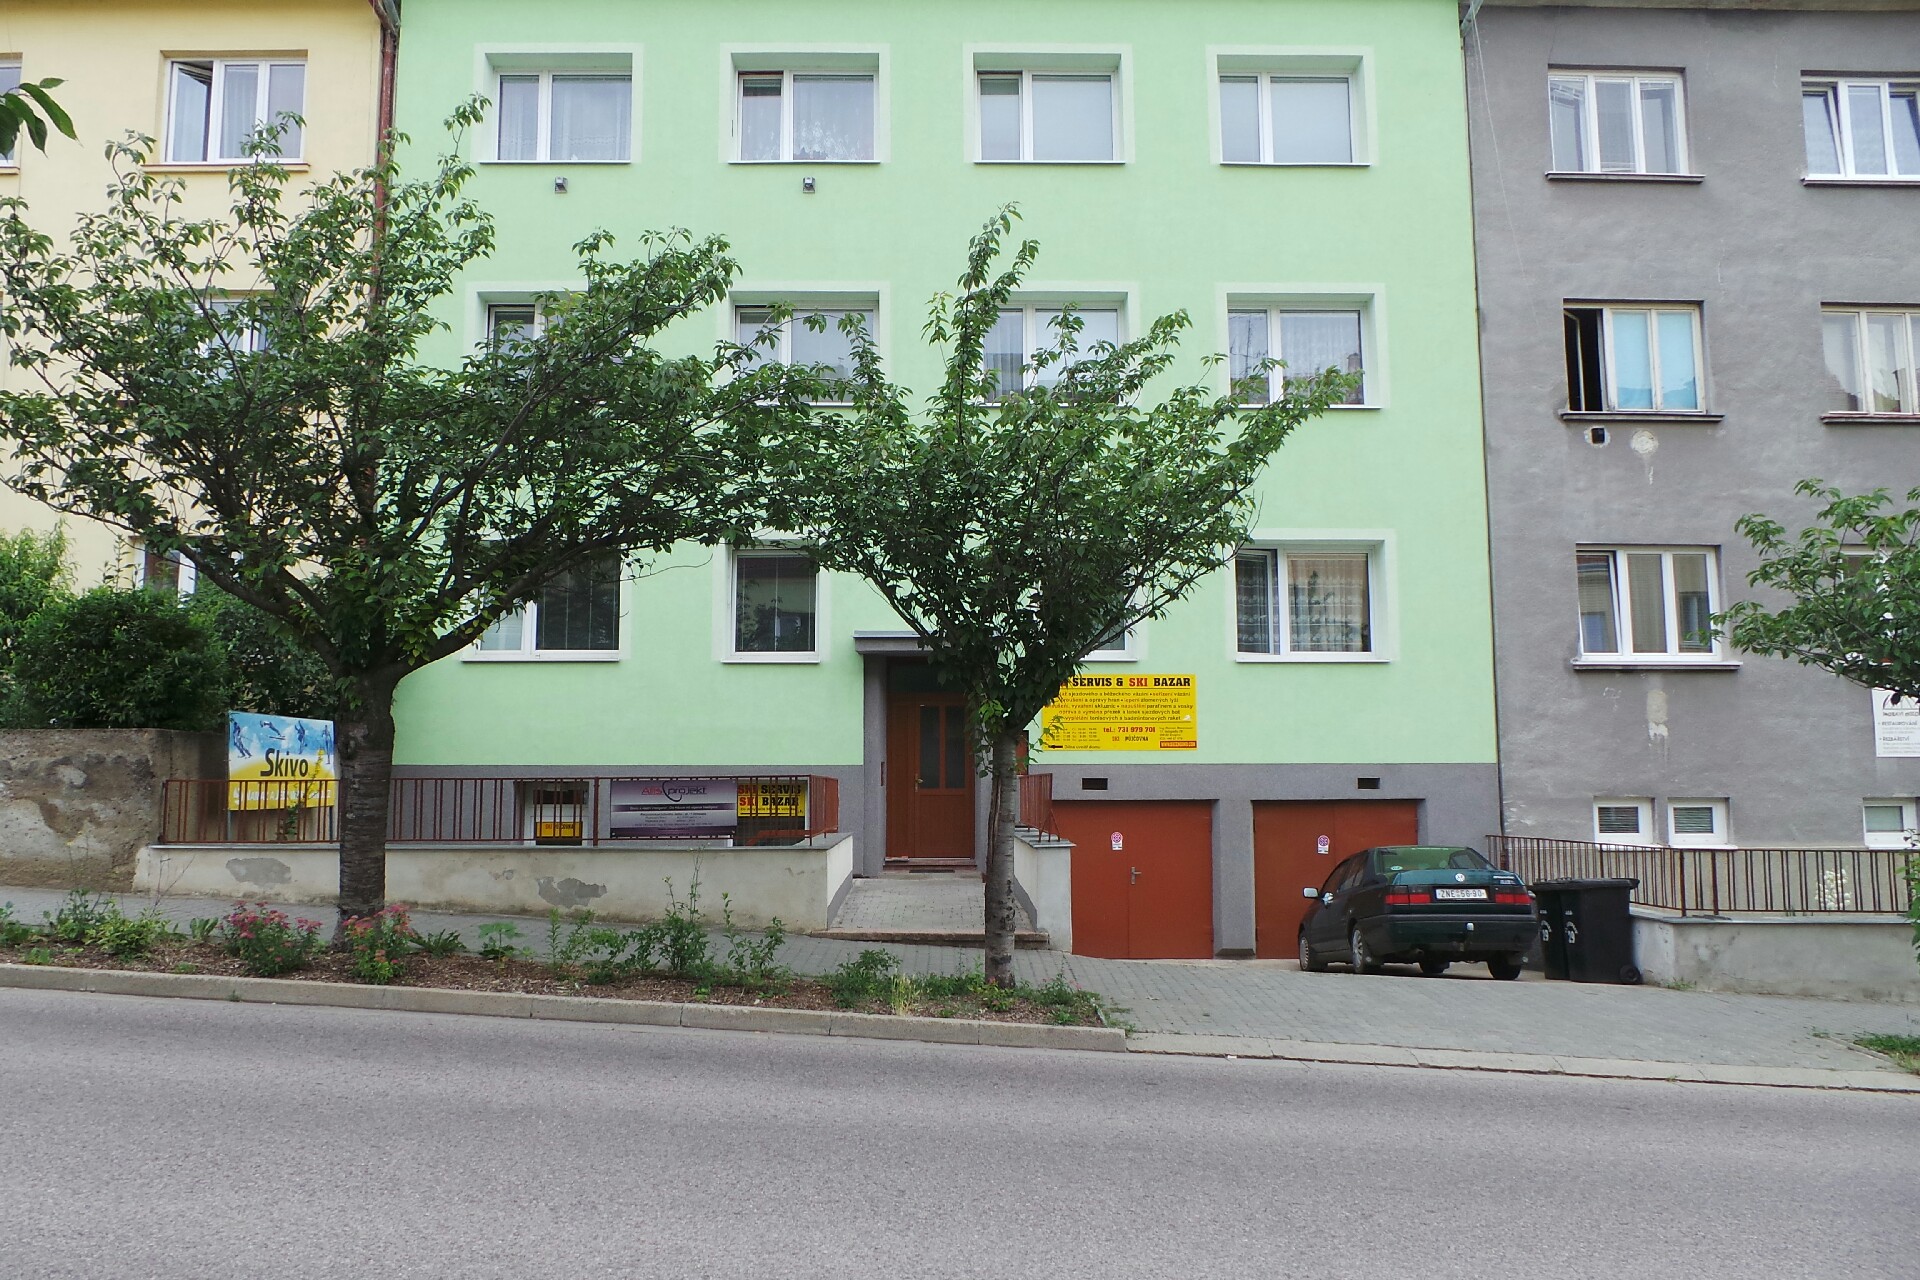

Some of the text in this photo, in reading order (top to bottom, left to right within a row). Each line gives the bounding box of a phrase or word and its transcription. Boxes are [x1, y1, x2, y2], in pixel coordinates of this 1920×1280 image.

[1072, 677, 1112, 687] SERVIS
[1116, 677, 1123, 687] &
[1129, 677, 1148, 687] SKI
[1153, 677, 1191, 687] BAZAR
[259, 747, 309, 777] Skivo
[761, 784, 801, 794] SERVIS
[762, 796, 799, 806] BAZAR
[1440, 889, 1456, 898] ZNE
